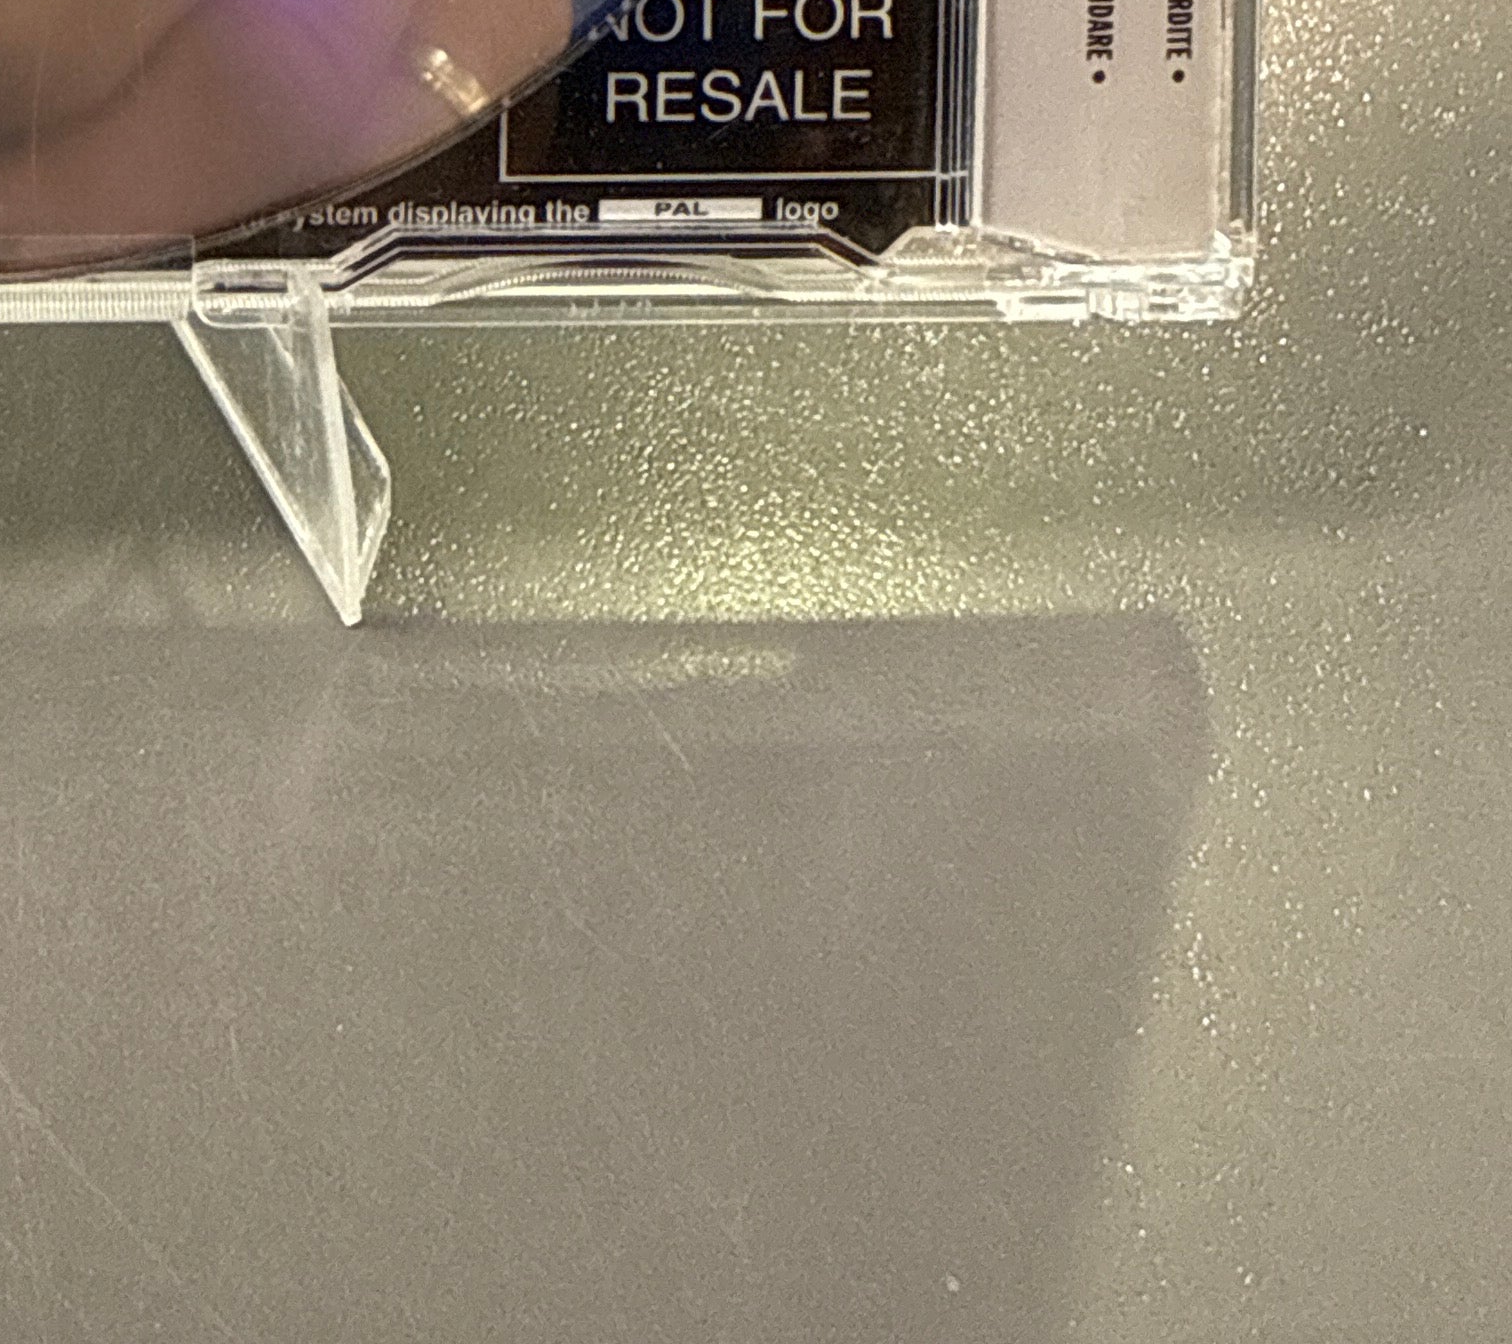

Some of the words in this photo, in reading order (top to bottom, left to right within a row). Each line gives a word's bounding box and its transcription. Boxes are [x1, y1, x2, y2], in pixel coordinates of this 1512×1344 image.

[605, 69, 873, 124] RESALE
[387, 200, 536, 226] displaying
[545, 199, 590, 223] the
[654, 201, 709, 217] PAL
[775, 197, 840, 225] logo
